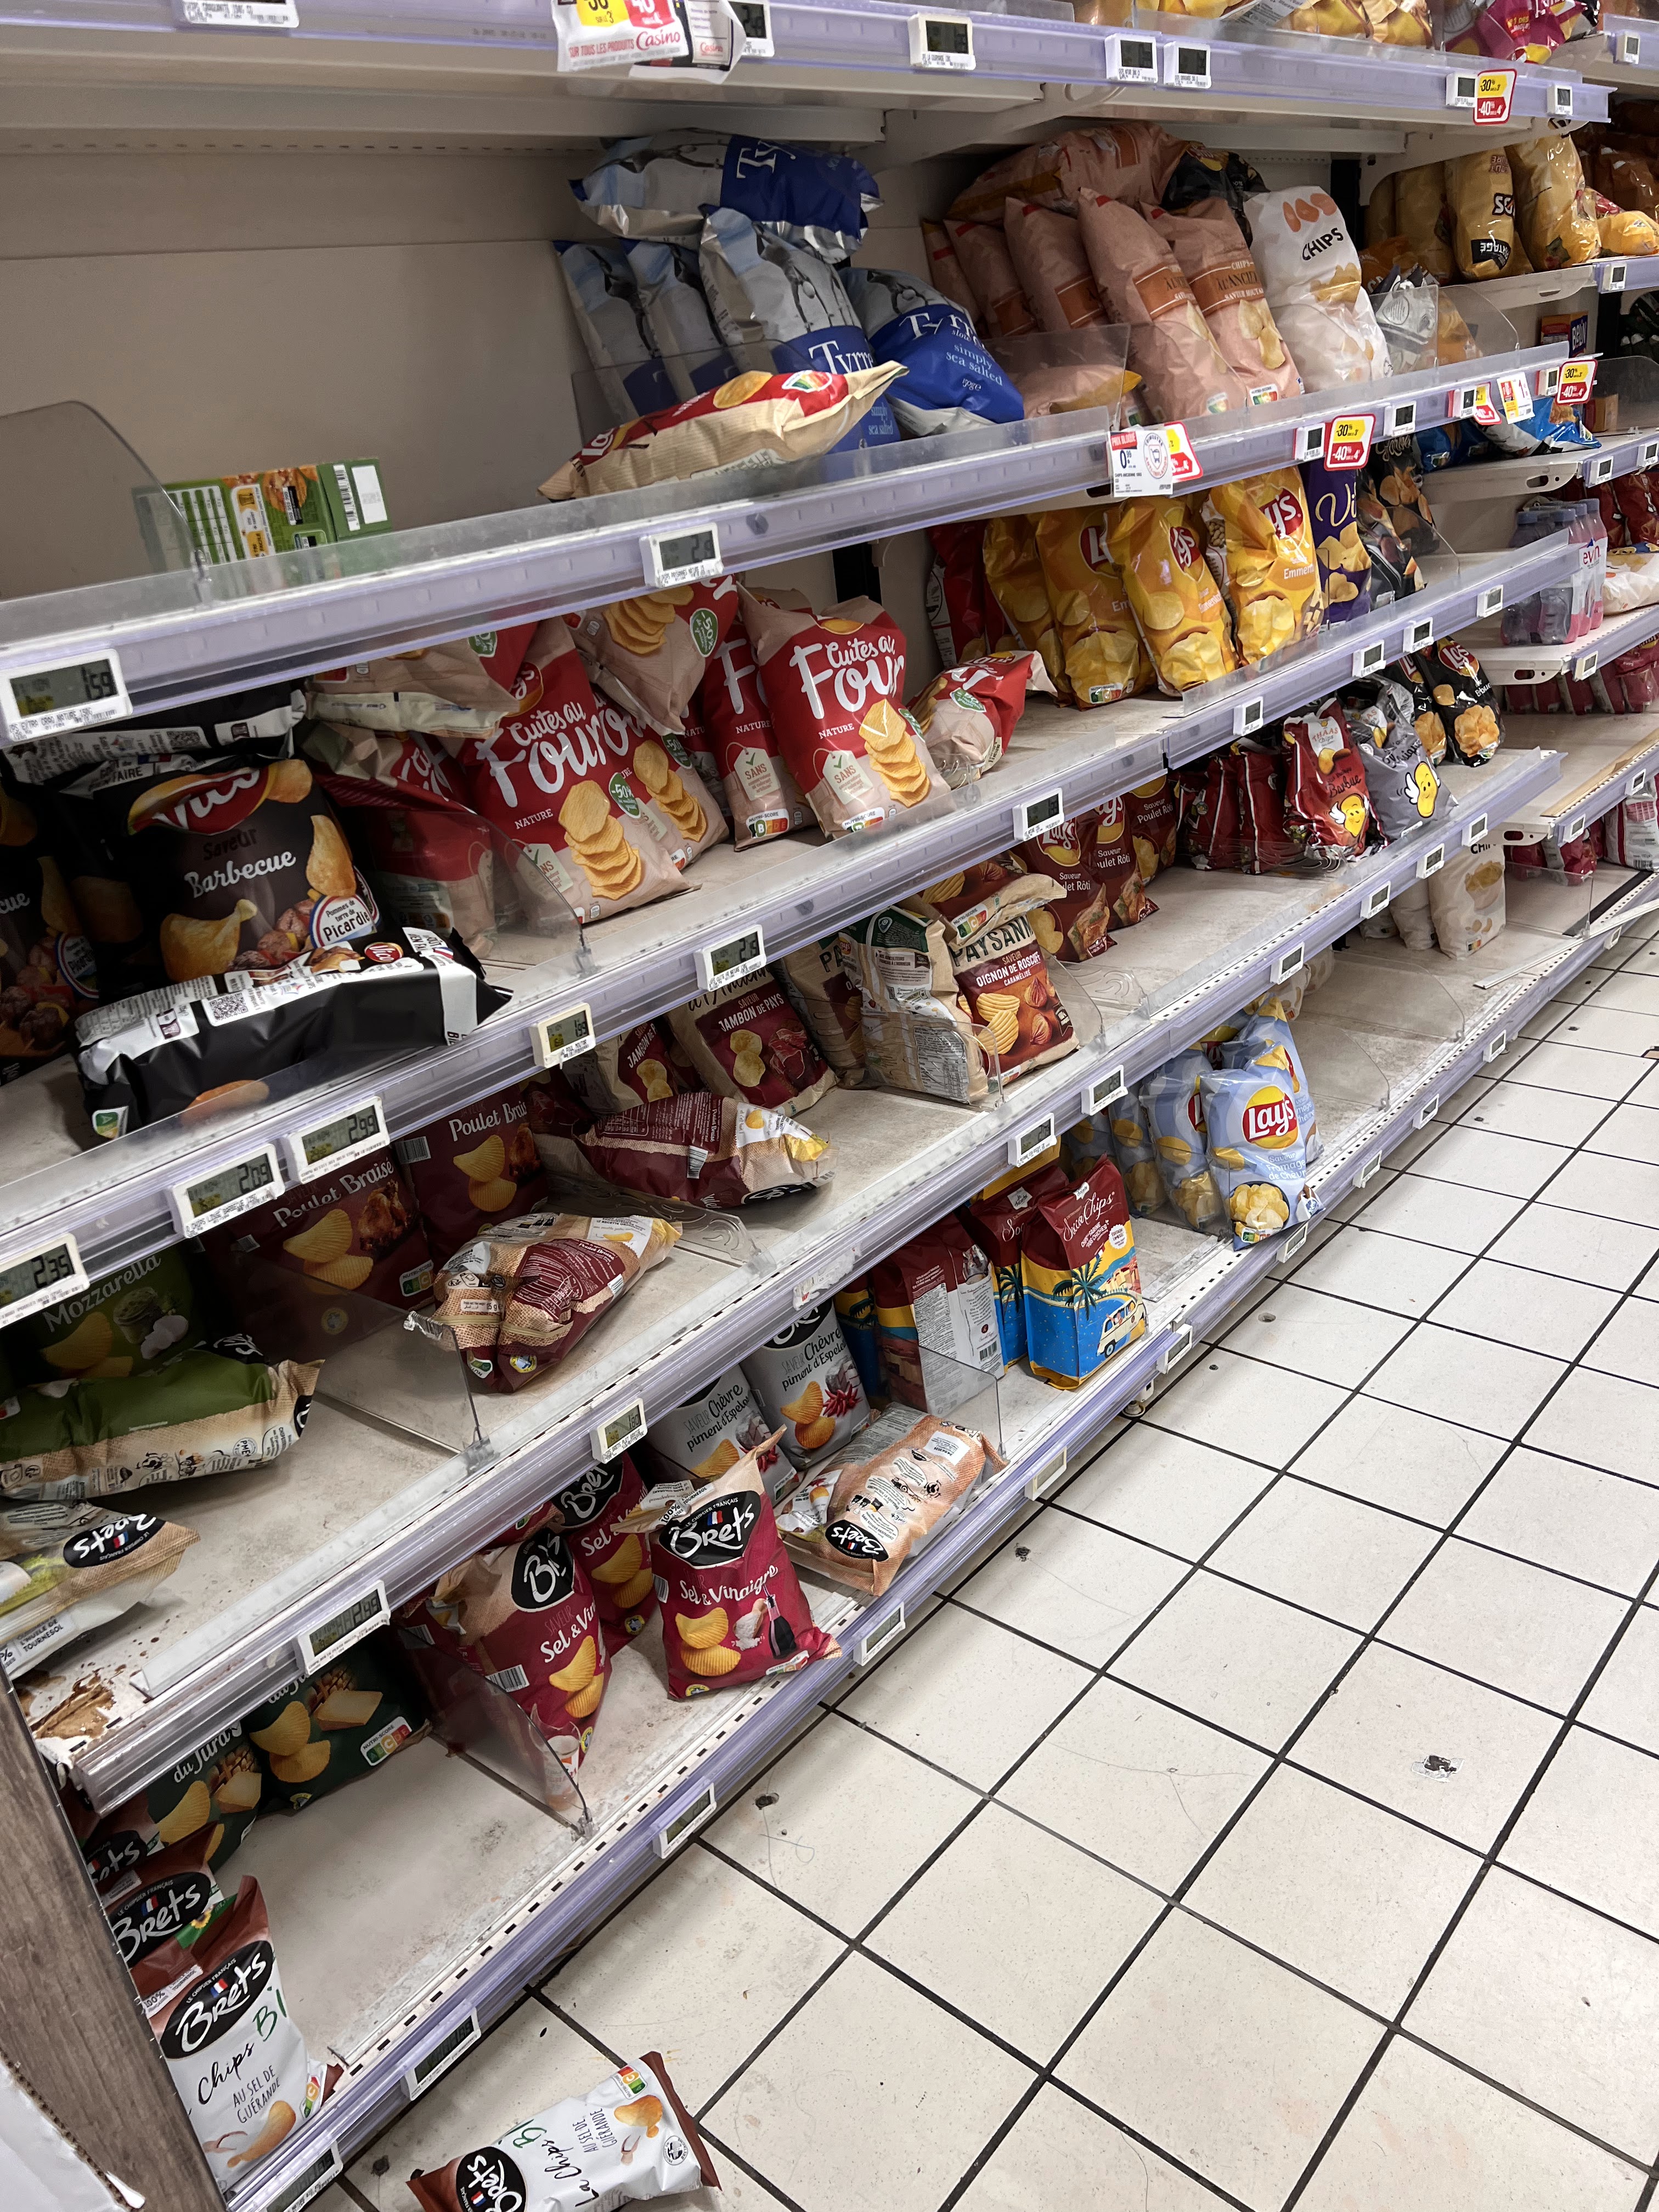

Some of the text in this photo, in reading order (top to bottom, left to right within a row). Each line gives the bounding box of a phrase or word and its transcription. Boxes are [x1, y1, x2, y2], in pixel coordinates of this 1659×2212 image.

[636, 29, 681, 50] Casino
[1302, 227, 1344, 262] CHIPS
[946, 351, 1003, 386] sea salted
[954, 343, 992, 369] simply
[825, 634, 895, 670] Cuites au
[789, 642, 905, 720] Four
[507, 701, 586, 747] Cuites au
[735, 720, 771, 735] NATURE
[817, 723, 855, 740] NATURE
[745, 763, 767, 780] SANS
[834, 765, 856, 783] SANS
[515, 808, 554, 830] NATURE
[749, 811, 778, 823] NUTRI-SCORE
[844, 811, 876, 826] NUTRI-SCORE
[1097, 796, 1122, 827] ay's
[1137, 803, 1173, 823] Poulet Rôti
[1143, 798, 1165, 811] Saveur
[203, 827, 258, 861] Saveur
[1098, 848, 1121, 857] Saveur
[184, 850, 296, 899] Barbecue
[1097, 853, 1130, 869] oulet Rôti
[1077, 881, 1091, 890] Rôti
[323, 911, 370, 940] Picardie
[953, 909, 978, 926] NUTRI-SCORE
[950, 916, 1034, 967] PAYSANN
[975, 951, 1041, 988] OIGNON DE ROSCOFF
[1003, 951, 1022, 965] SAVEUR
[1004, 969, 1031, 986] CARAMÉLISÉ
[719, 992, 785, 1033] JAMBON DE PAYS
[738, 992, 760, 1009] SAVEUR
[627, 1041, 649, 1069] JAMBON
[448, 1099, 528, 1142] Poulet Brais
[1248, 1098, 1295, 1140] Lay's
[1266, 1160, 1306, 1172] Fromage
[1268, 1152, 1297, 1163] Saveur
[1268, 1172, 1280, 1181] de
[273, 1157, 394, 1228] Poulet Braisé
[1064, 1192, 1114, 1242] Socca Chips
[402, 1262, 433, 1279] NUTRI-SCORE
[42, 1255, 161, 1333] Mozzarella
[782, 1352, 805, 1375] SAVEUR
[804, 1325, 842, 1362] Chèvre
[782, 1367, 814, 1391] piment
[684, 1383, 743, 1434] SAVEUR Chèvre
[686, 1425, 722, 1452] piment
[561, 1463, 614, 1519] Bret
[684, 1487, 707, 1504] TOURNESOL
[661, 1504, 680, 1523] 100%
[692, 1508, 713, 1522] CHIPSIER
[713, 1498, 738, 1508] FRANÇAIS
[74, 1514, 156, 1559] Brets
[580, 1529, 611, 1558] Sel
[669, 1503, 755, 1559] Brets
[831, 1524, 884, 1555] Brets
[681, 1565, 779, 1606] Sel & Vinaigre
[23, 1625, 64, 1652] TOURNESOL
[540, 1624, 581, 1664] Sel &
[362, 1723, 395, 1748] NUTRI-SCORE
[173, 1728, 230, 1783] du Jura
[117, 1880, 174, 1916] LE CHIPSIER FRANÇAIS
[111, 1882, 201, 1961] Brets
[187, 1958, 236, 2004] LE CHIPSIER FRANÇAIS
[144, 1990, 165, 2007] 100%
[178, 1950, 267, 2053] Brets
[198, 2042, 255, 2106] Chips
[233, 2064, 276, 2107] AU SEL DE
[236, 2076, 281, 2124] GUÉRANDE
[572, 2119, 599, 2153] AU SEL DE
[589, 2108, 618, 2148] GUÉRANDE
[541, 2139, 600, 2208] La Chips
